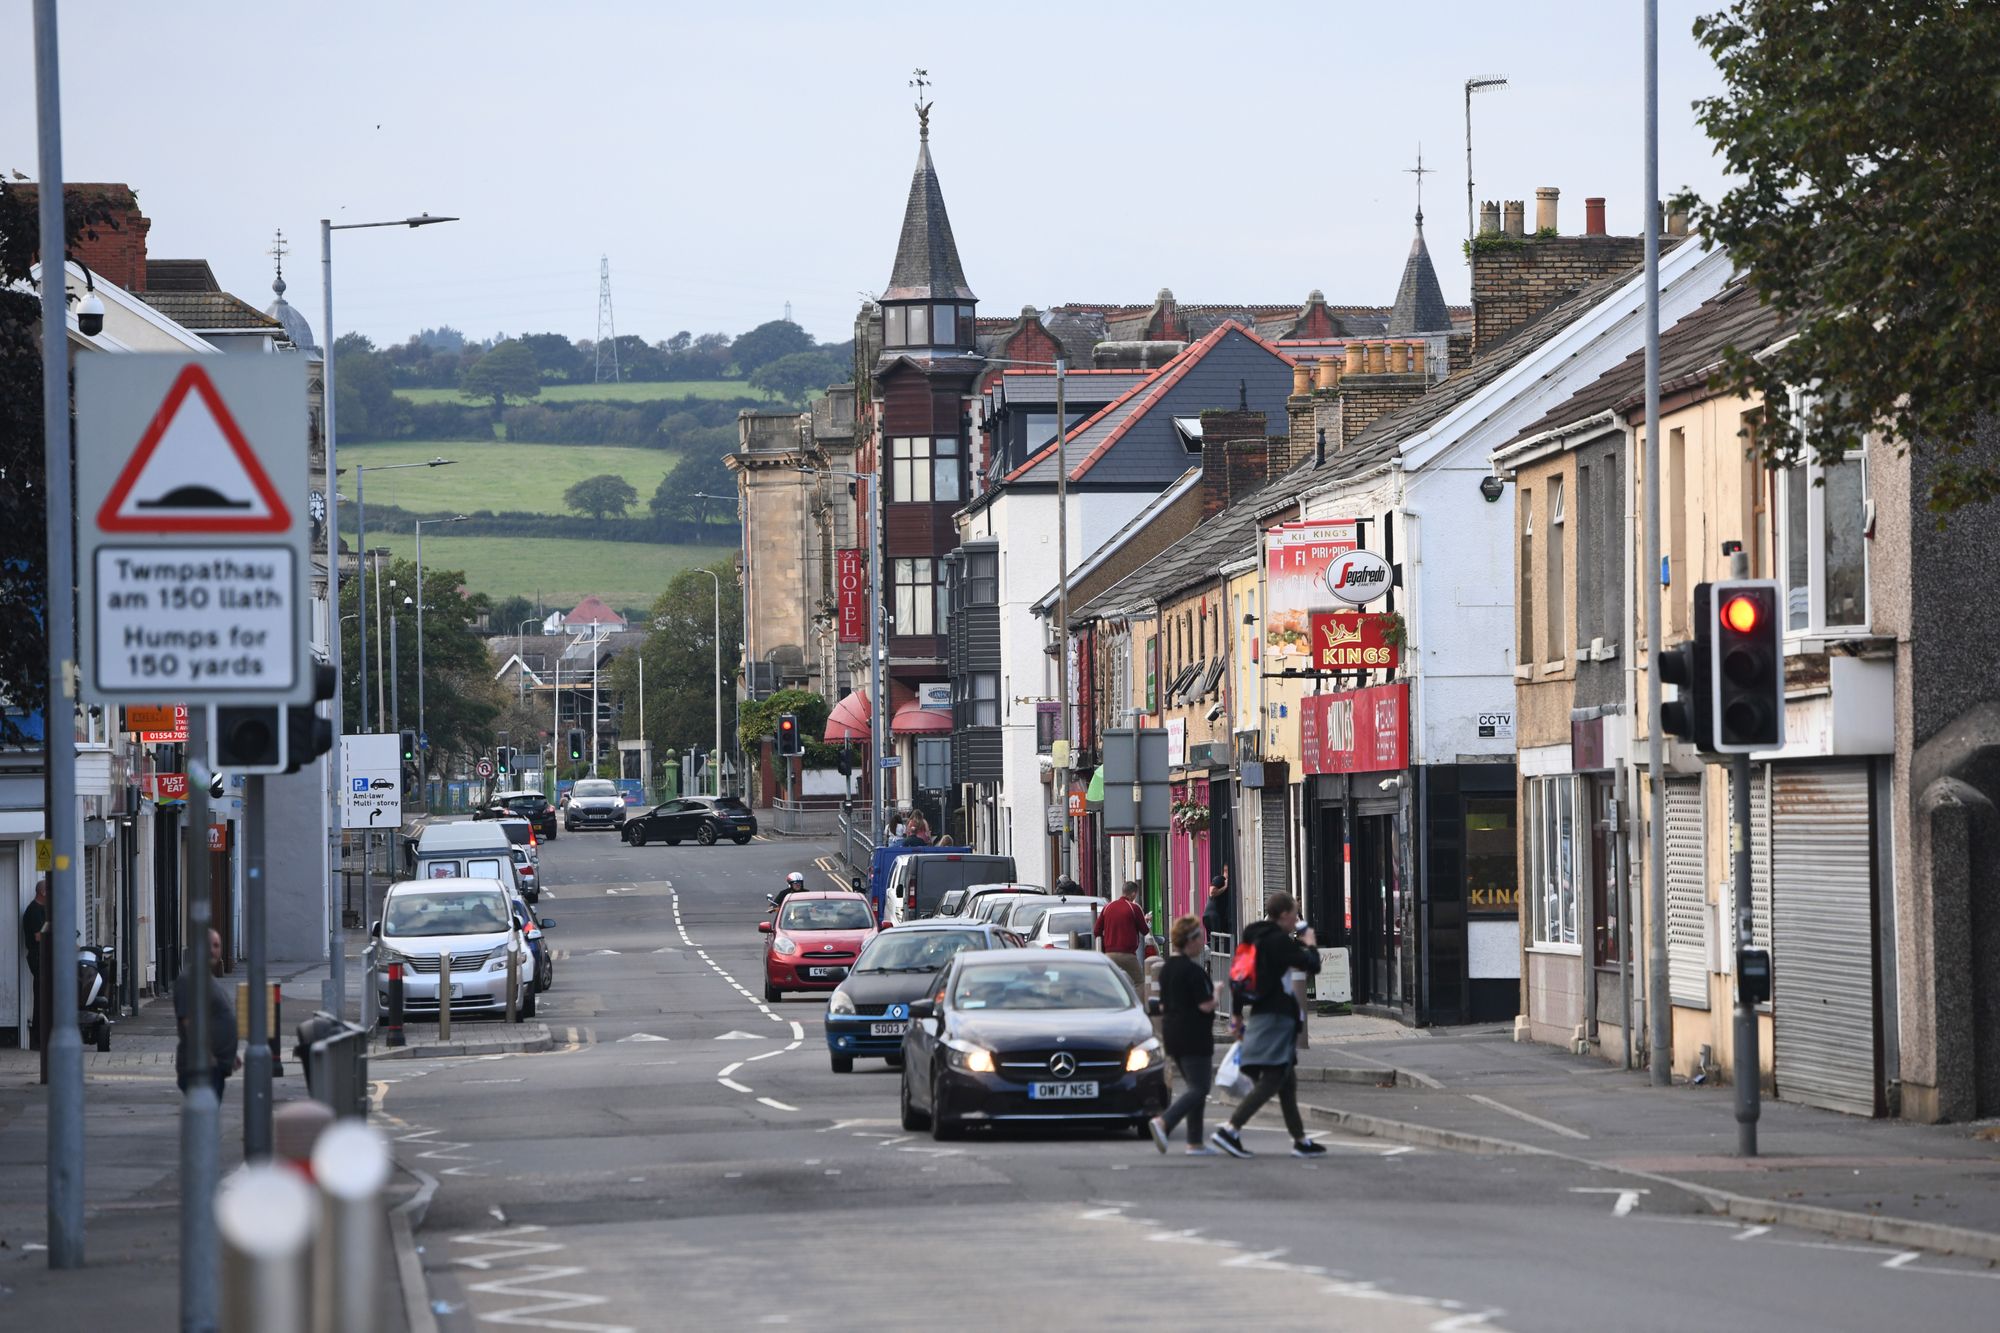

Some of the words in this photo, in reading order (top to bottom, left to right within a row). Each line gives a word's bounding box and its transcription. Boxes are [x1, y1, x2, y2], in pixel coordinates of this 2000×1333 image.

[1313, 529, 1348, 538] KING'S
[1311, 547, 1329, 559] PIRI
[115, 558, 275, 582] Twmpathau
[1334, 561, 1386, 589] Segafredo
[108, 590, 148, 609] am
[159, 586, 209, 609] 150
[219, 587, 284, 609] llath
[842, 560, 858, 636] HOTEL
[123, 626, 219, 649] Humps
[229, 626, 269, 647] for
[1322, 647, 1391, 665] KINGS
[128, 654, 179, 676] 150
[189, 653, 265, 679] yards
[1479, 715, 1511, 725] CCTV
[162, 776, 184, 786] JUST
[167, 784, 184, 793] EAT
[1070, 1083, 1093, 1096] NSE
